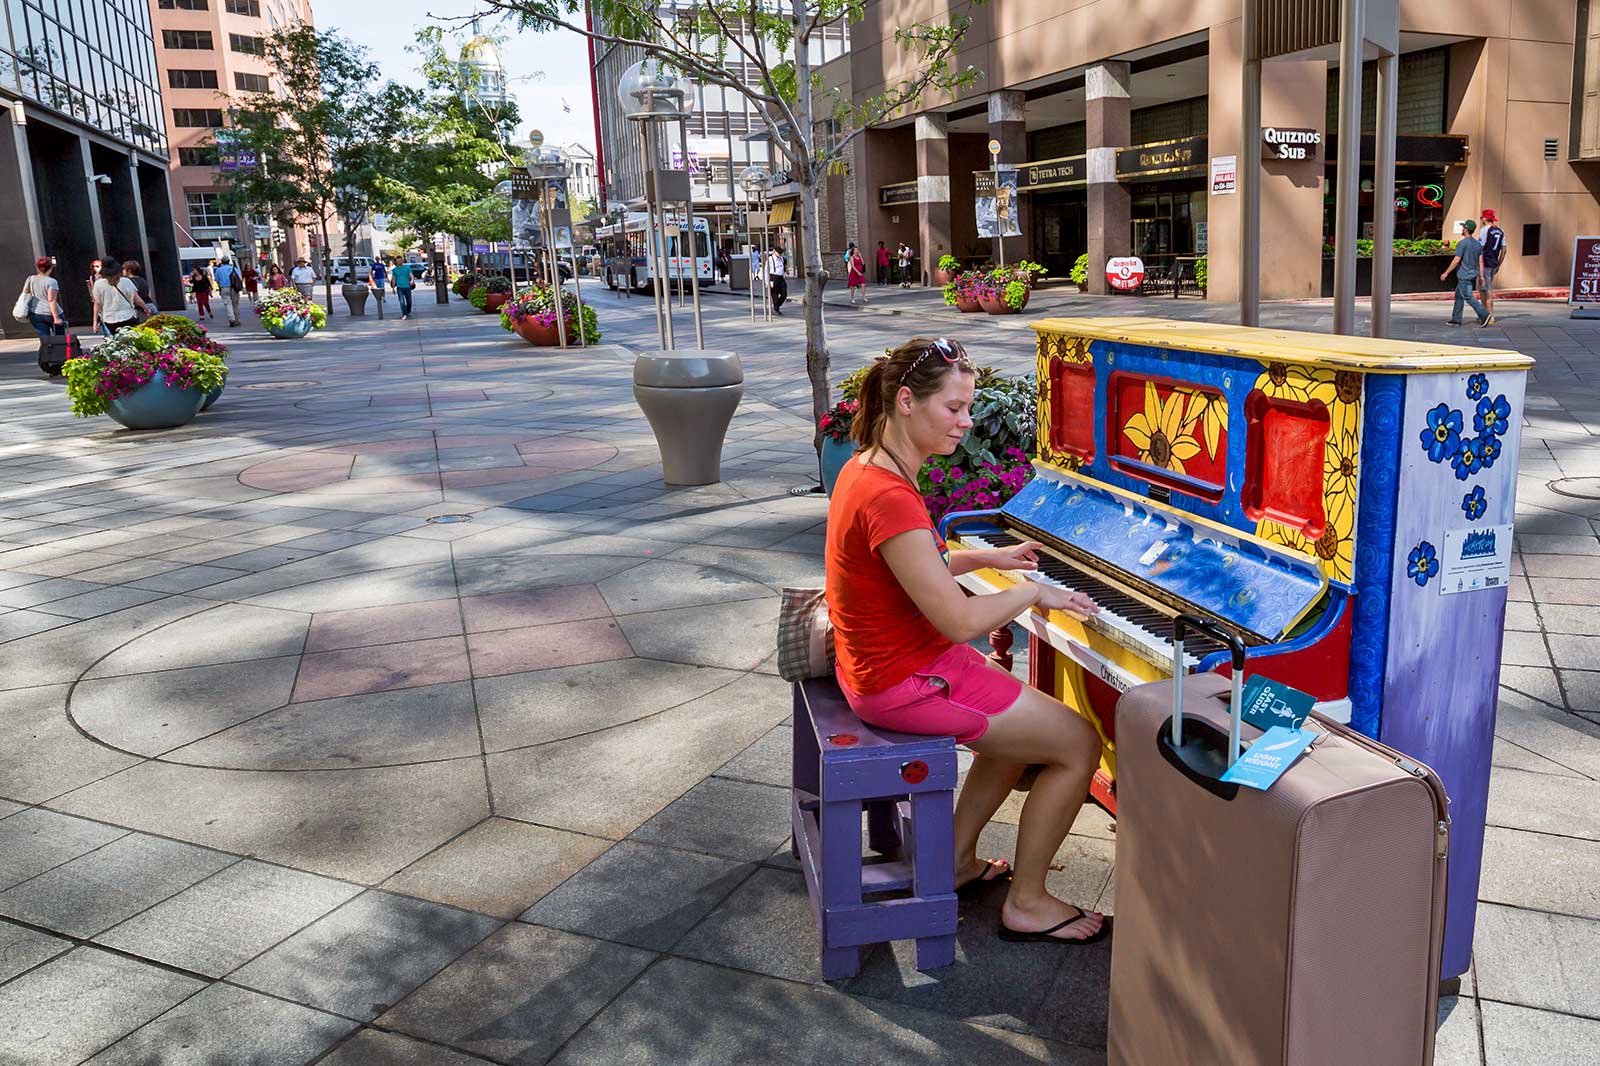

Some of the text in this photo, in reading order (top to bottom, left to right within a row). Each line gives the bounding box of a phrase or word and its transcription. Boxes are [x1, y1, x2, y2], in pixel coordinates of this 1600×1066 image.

[1039, 168, 1057, 179] TETRA
[1057, 165, 1074, 177] TECH
[1492, 234, 1501, 250] 7
[1249, 686, 1272, 715] GLIDER
[1259, 692, 1276, 715] EASY
[1244, 757, 1281, 769] WEIGHT
[1254, 751, 1281, 763] LIGHT
